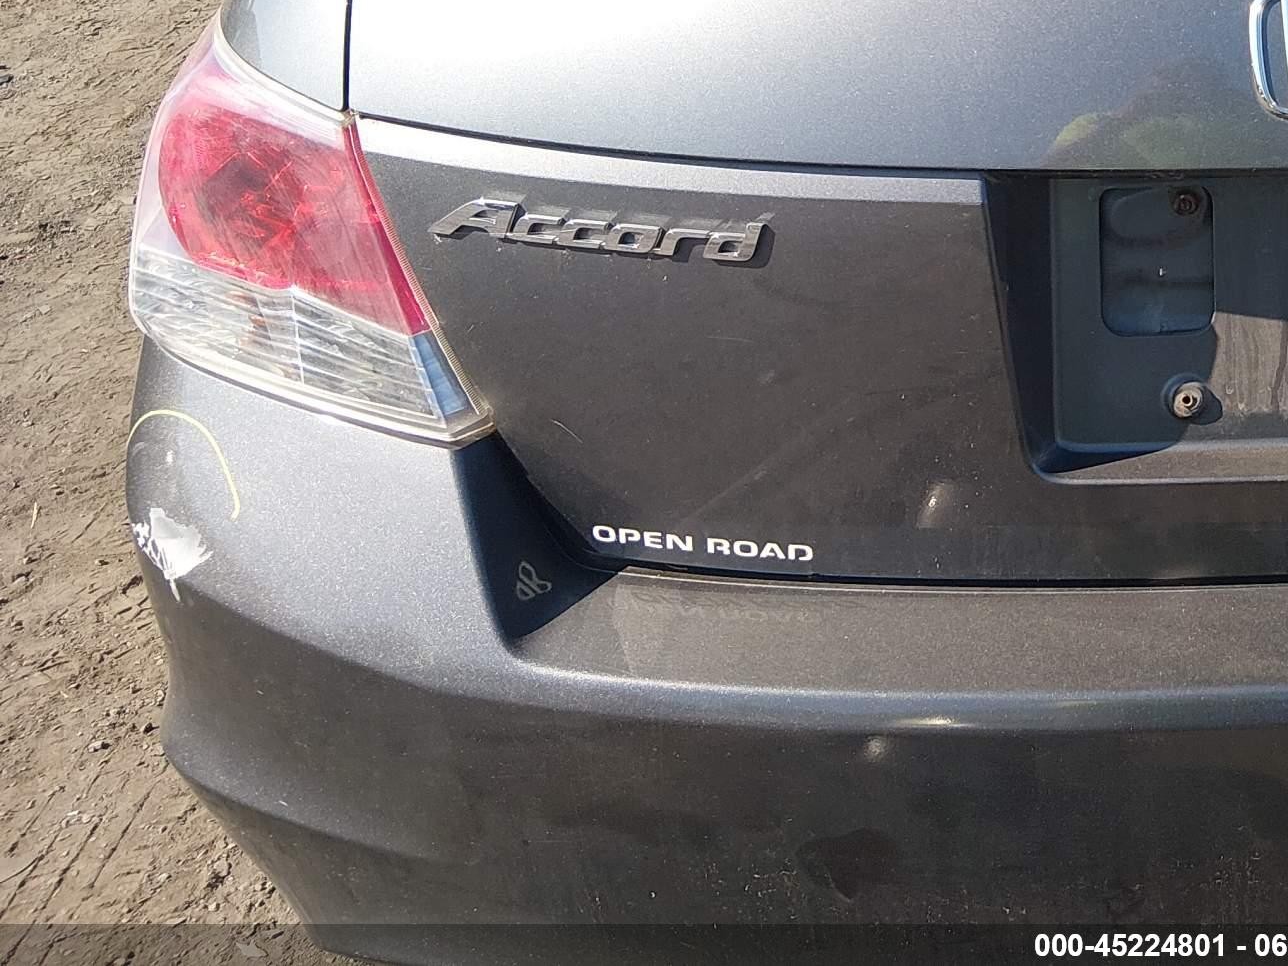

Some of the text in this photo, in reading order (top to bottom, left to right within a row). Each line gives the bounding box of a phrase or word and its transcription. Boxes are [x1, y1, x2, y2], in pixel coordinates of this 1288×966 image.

[427, 197, 771, 264] Accord
[591, 524, 814, 561] OPEN ROAD
